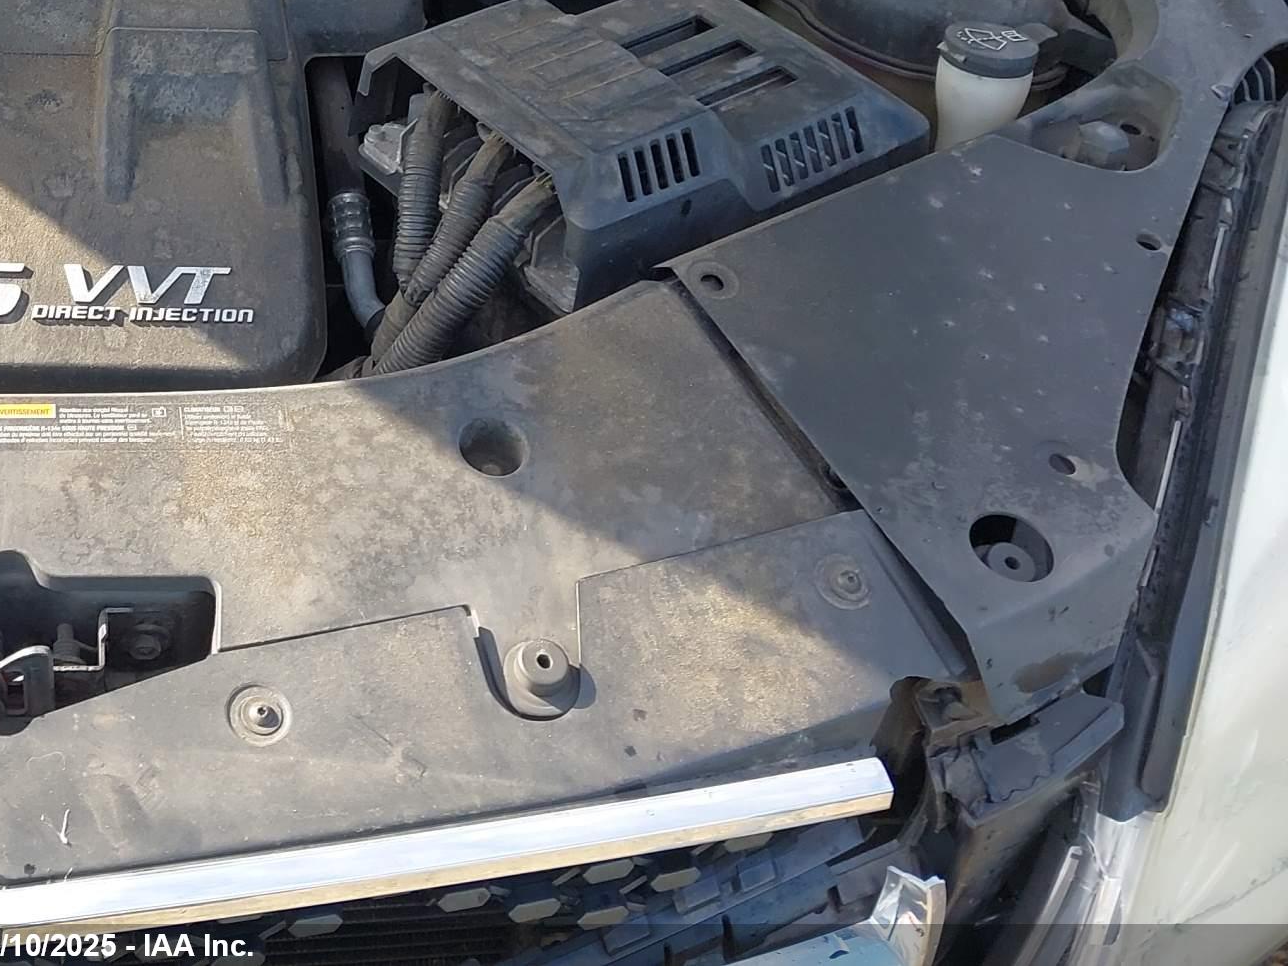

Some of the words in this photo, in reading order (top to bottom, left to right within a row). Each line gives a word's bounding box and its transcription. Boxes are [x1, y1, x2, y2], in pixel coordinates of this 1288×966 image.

[64, 263, 232, 304] VVT
[31, 305, 121, 321] DIRECT
[128, 307, 254, 323] INJECTION
